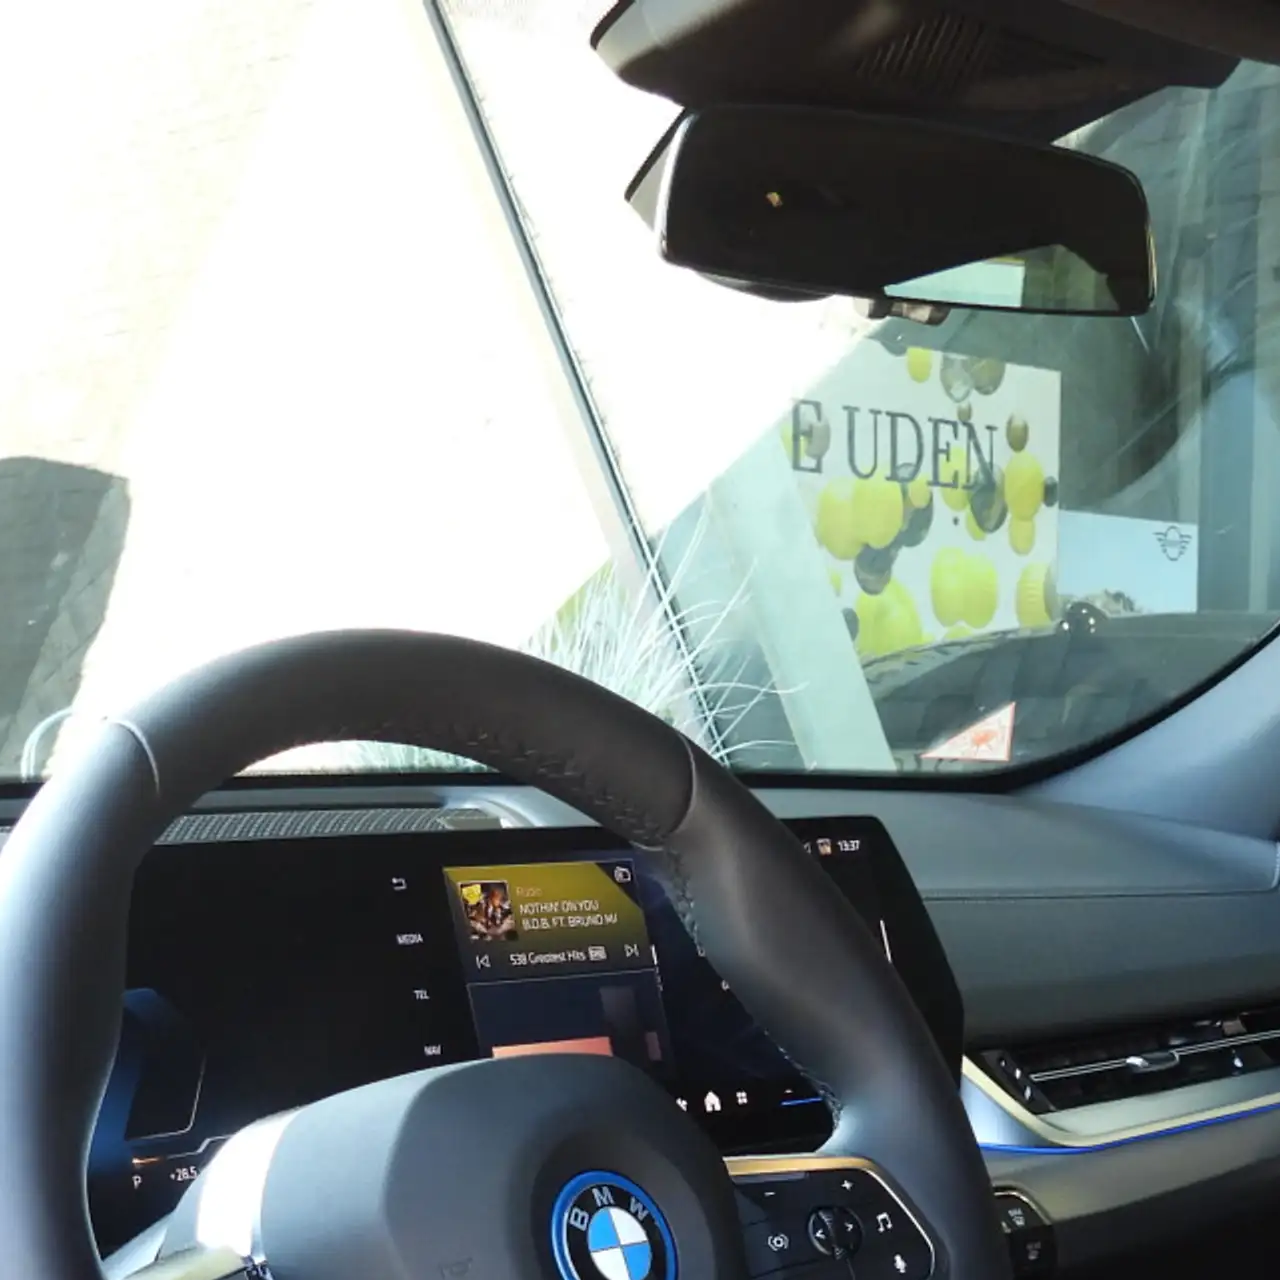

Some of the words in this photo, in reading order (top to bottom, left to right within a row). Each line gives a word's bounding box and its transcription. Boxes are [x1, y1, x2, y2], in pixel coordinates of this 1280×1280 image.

[841, 404, 999, 490] UDEN
[413, 989, 430, 1000] TEL
[568, 1185, 650, 1233] BMW
